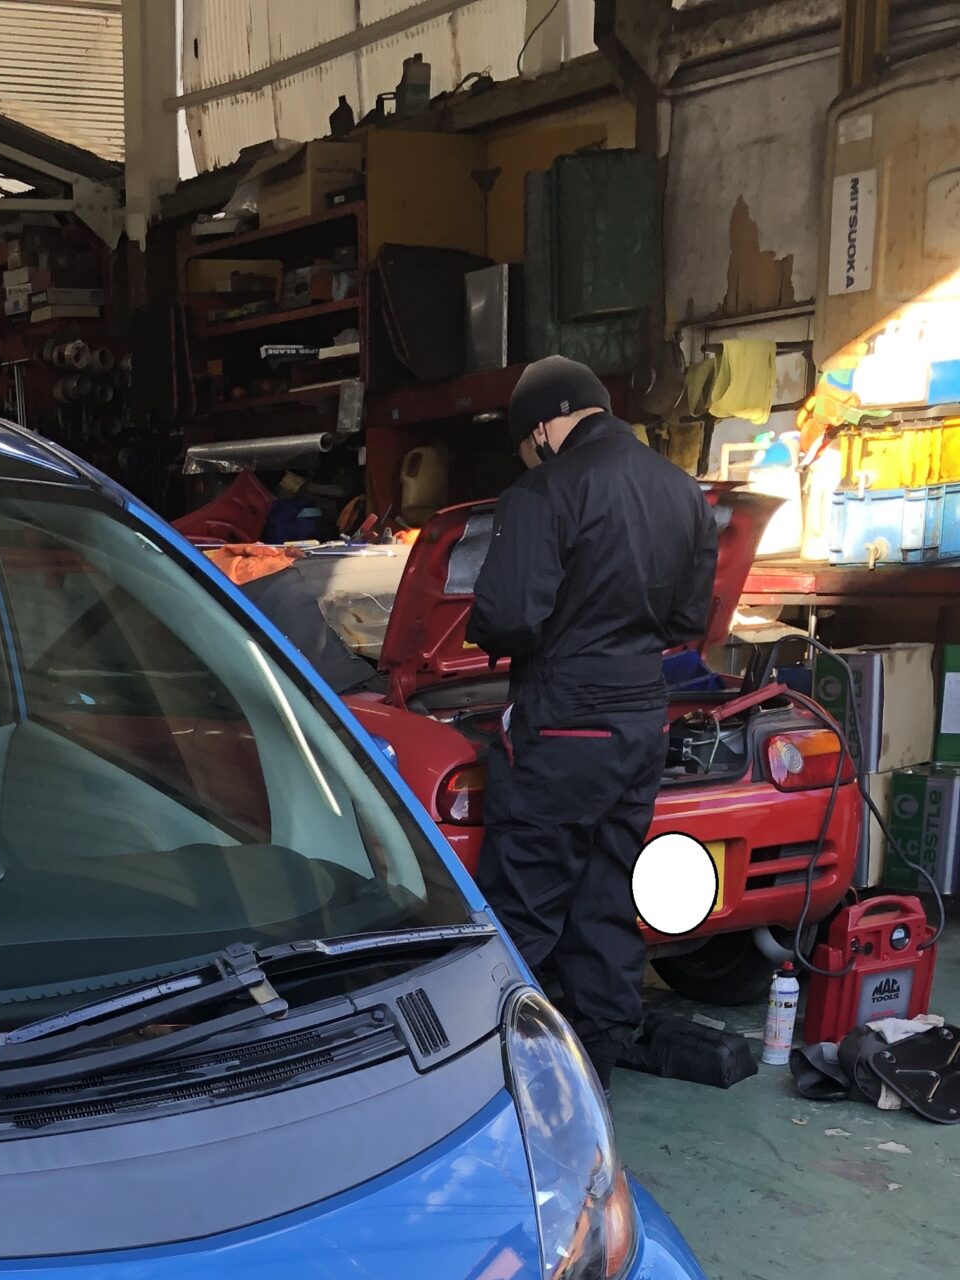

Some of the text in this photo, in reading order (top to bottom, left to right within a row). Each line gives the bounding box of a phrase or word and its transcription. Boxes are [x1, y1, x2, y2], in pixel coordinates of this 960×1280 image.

[845, 177, 860, 289] MITSUOKA
[871, 977, 901, 997] MAC
[871, 993, 900, 1004] TOOLS
